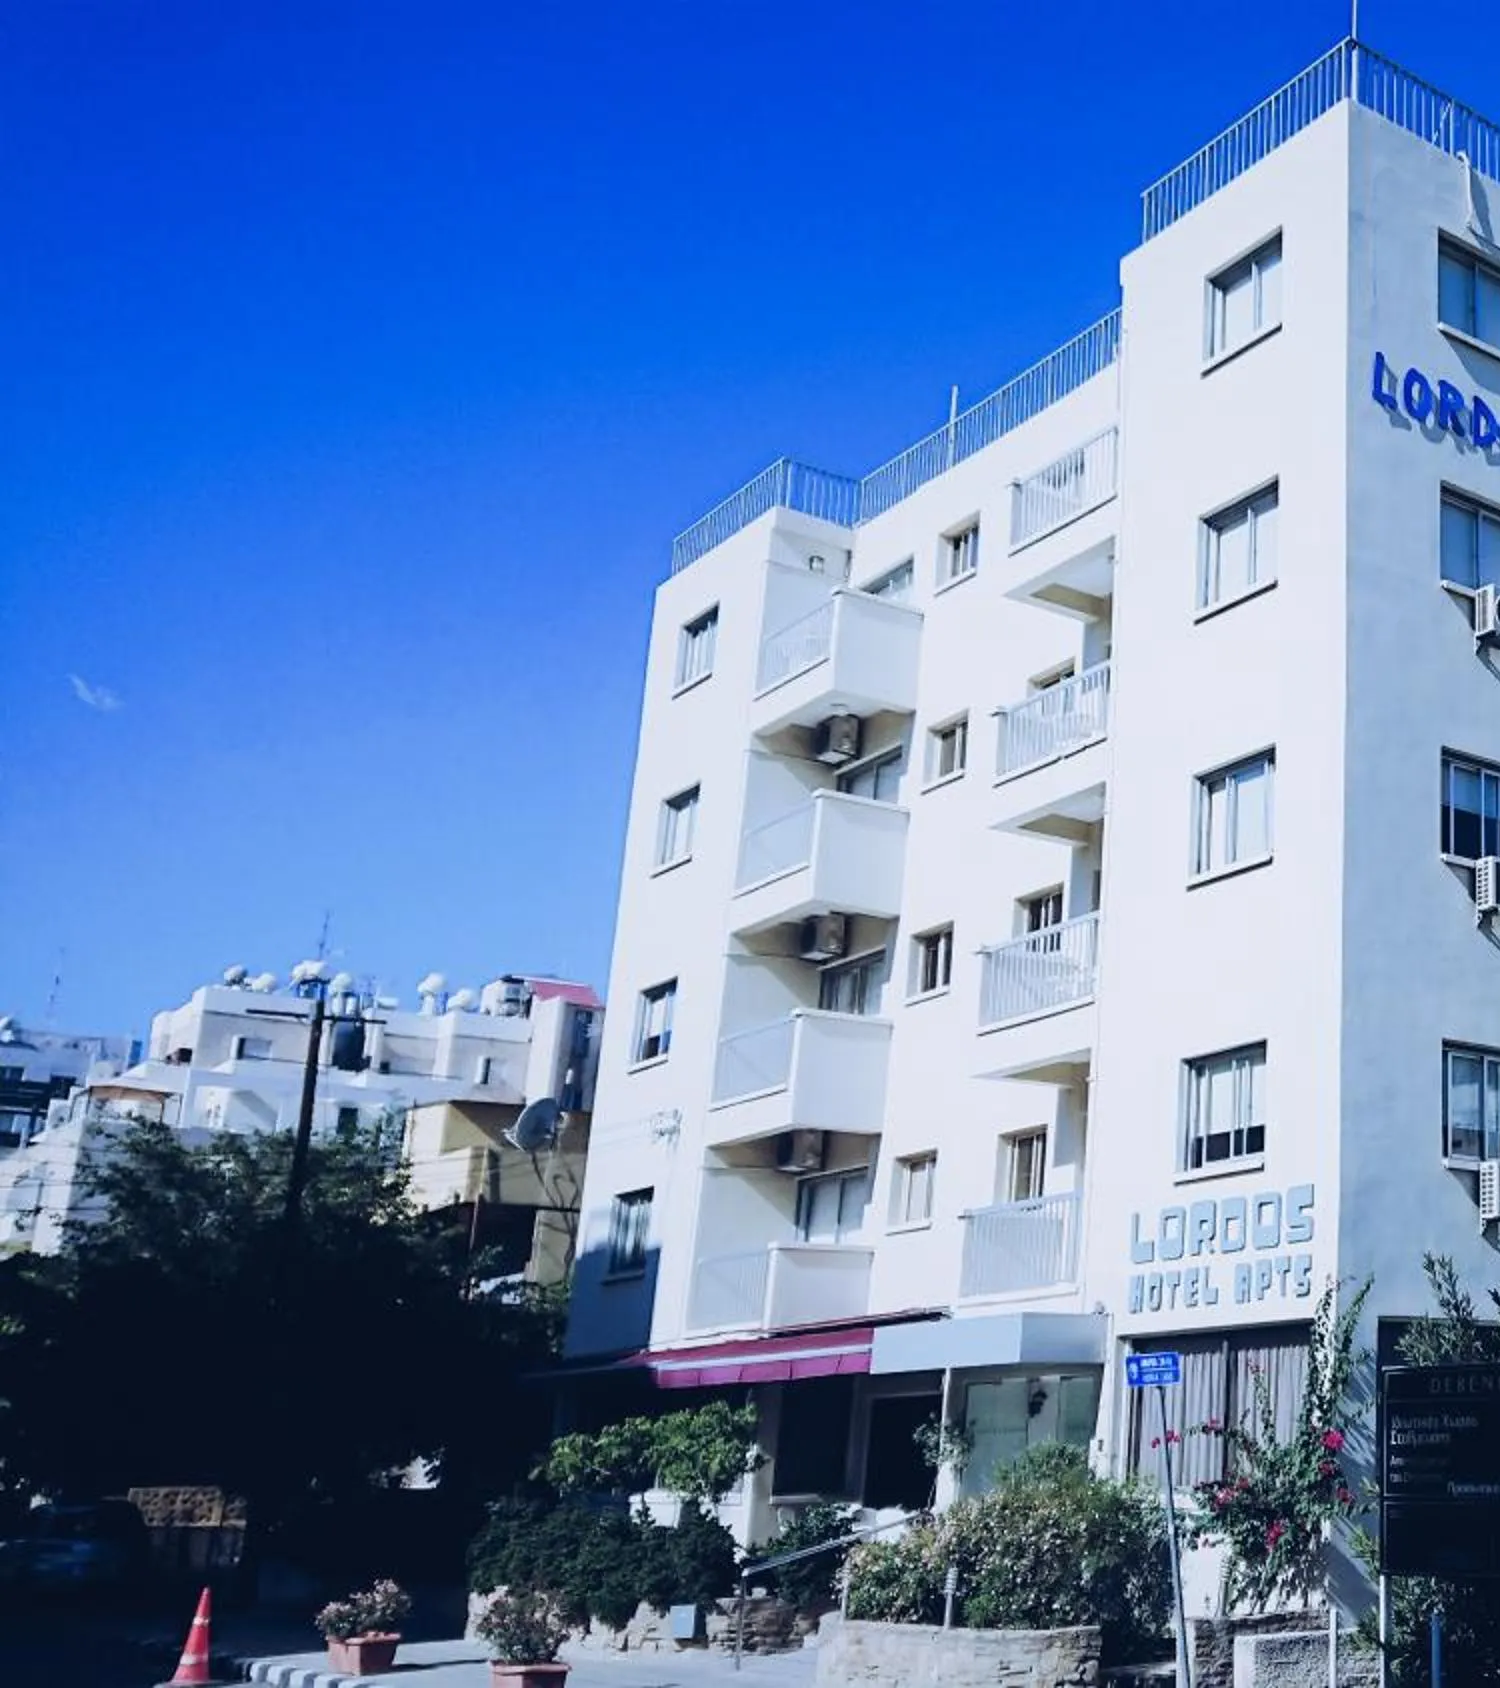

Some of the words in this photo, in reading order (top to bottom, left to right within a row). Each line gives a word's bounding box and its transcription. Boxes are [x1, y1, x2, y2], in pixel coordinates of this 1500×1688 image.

[1131, 1183, 1315, 1264] LORDOS
[1129, 1266, 1218, 1314] HOTEL
[1235, 1254, 1312, 1304] APTS
